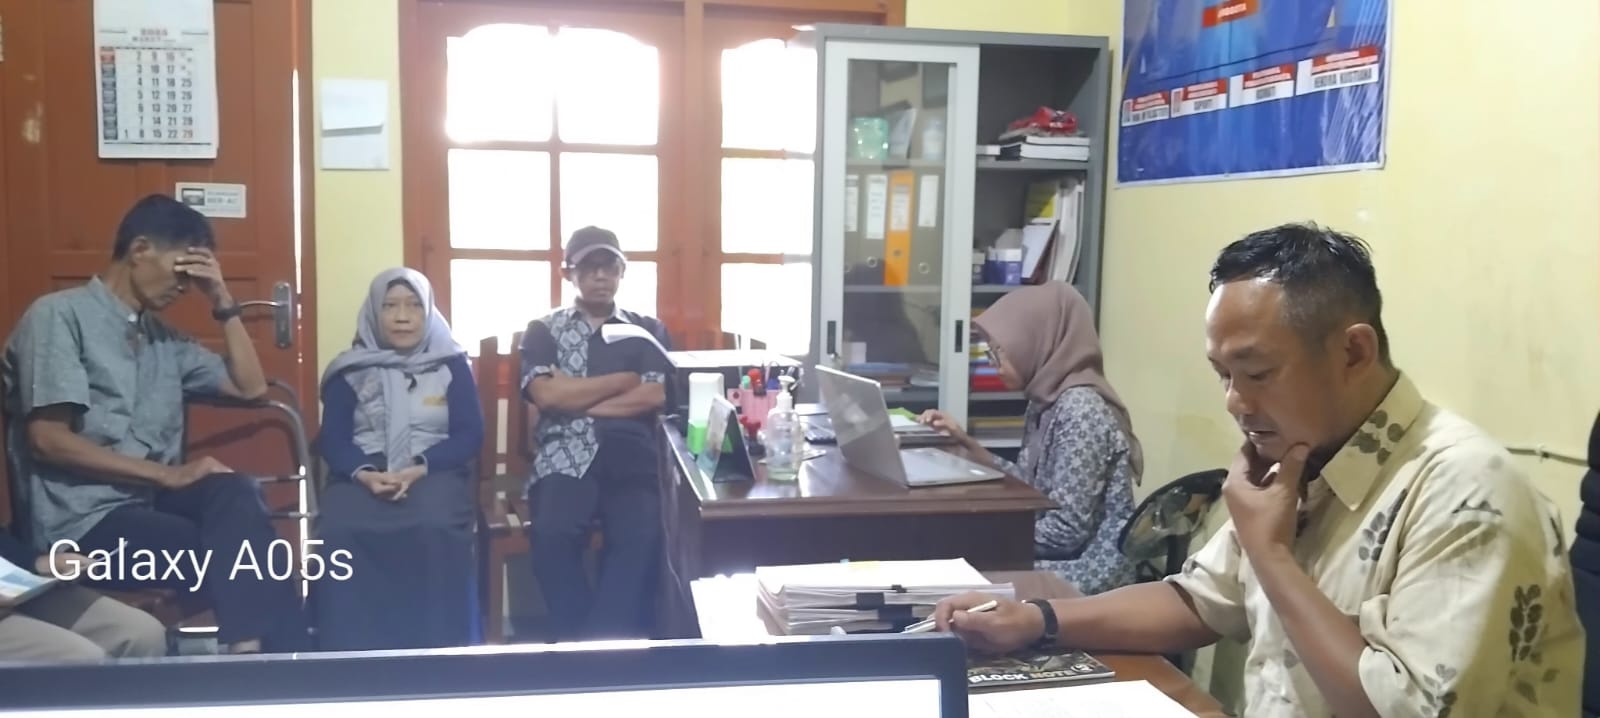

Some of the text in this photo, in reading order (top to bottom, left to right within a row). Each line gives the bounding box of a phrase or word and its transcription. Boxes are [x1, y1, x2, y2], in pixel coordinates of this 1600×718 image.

[152, 78, 160, 87] 11
[152, 90, 160, 100] 12
[167, 104, 177, 113] 20
[183, 103, 192, 113] 27
[168, 116, 177, 126] 21
[153, 129, 162, 139] 15
[168, 129, 178, 139] 22
[968, 670, 1074, 683] BLOCK NOTE
